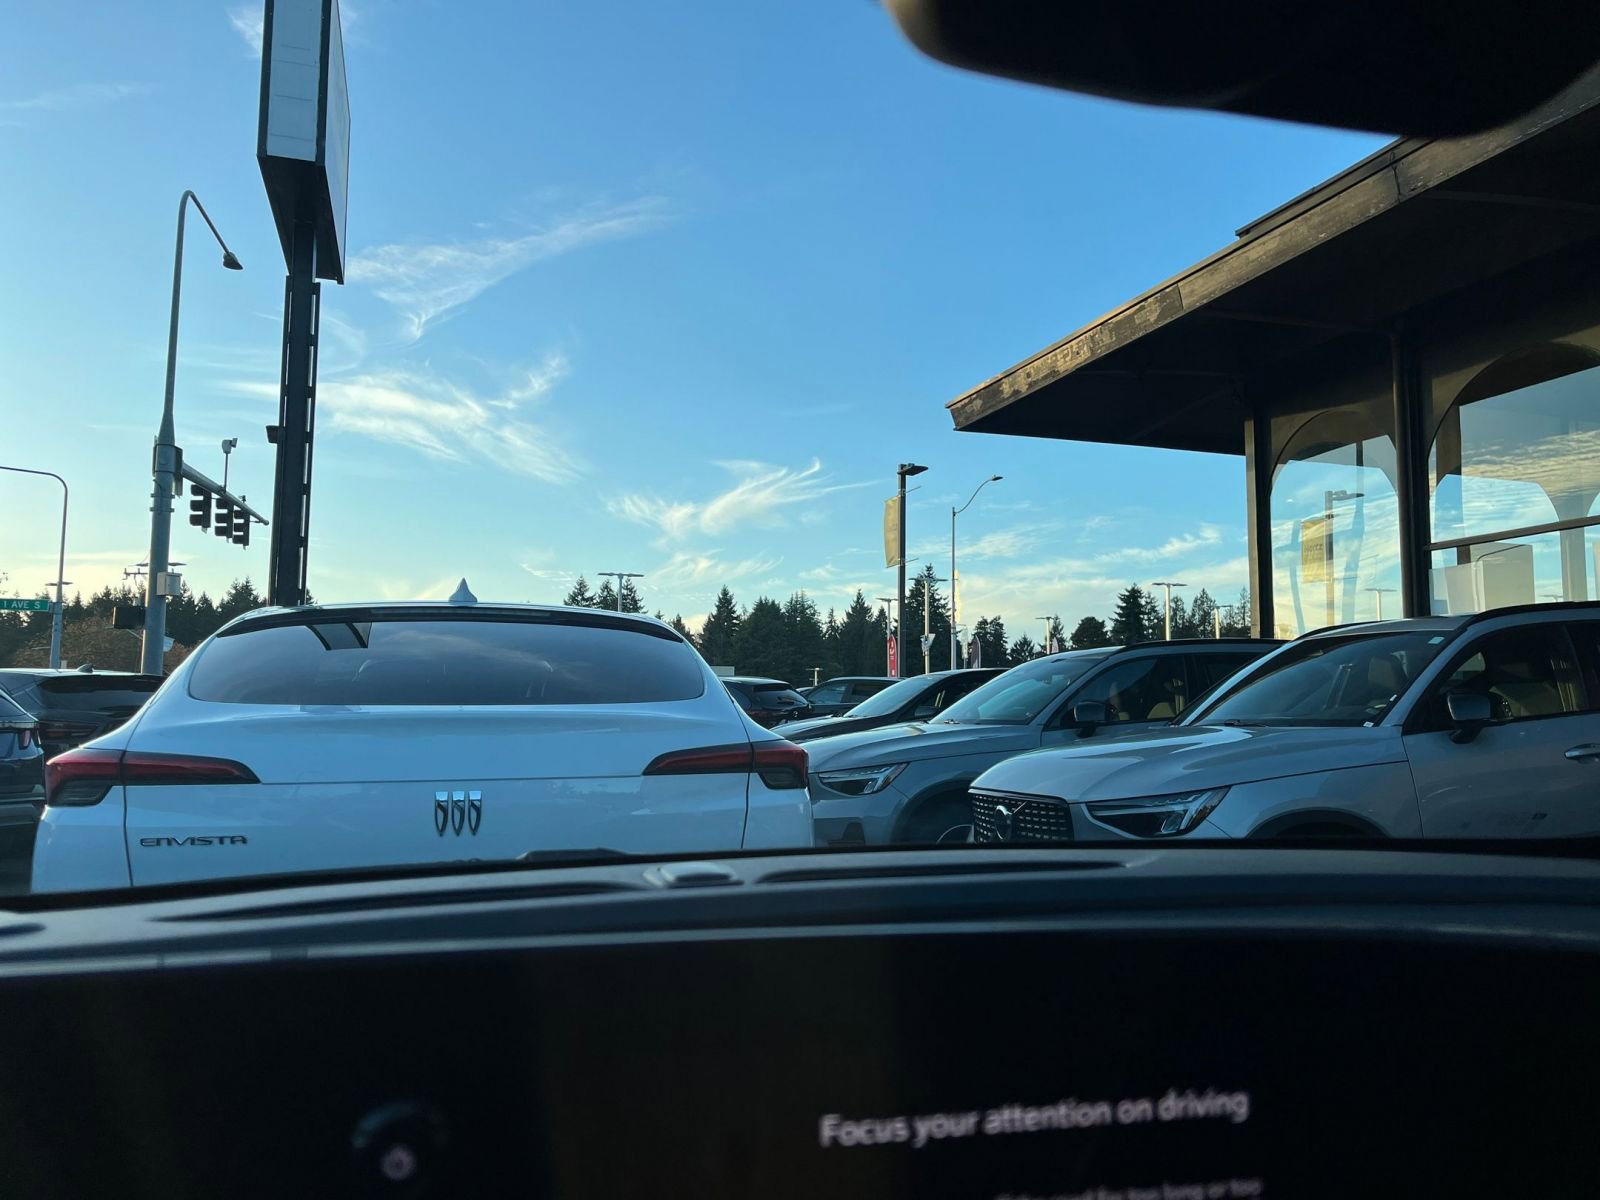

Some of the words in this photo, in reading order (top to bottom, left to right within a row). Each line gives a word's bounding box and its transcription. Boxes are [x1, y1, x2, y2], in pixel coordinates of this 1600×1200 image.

[11, 600, 30, 609] AVE
[34, 601, 41, 609] S
[140, 835, 248, 847] ENVISTA
[819, 1113, 909, 1148] Focus
[912, 1111, 979, 1148] your
[983, 1098, 1112, 1135] attention
[1117, 1098, 1153, 1124] on
[1158, 1087, 1249, 1124] driving
